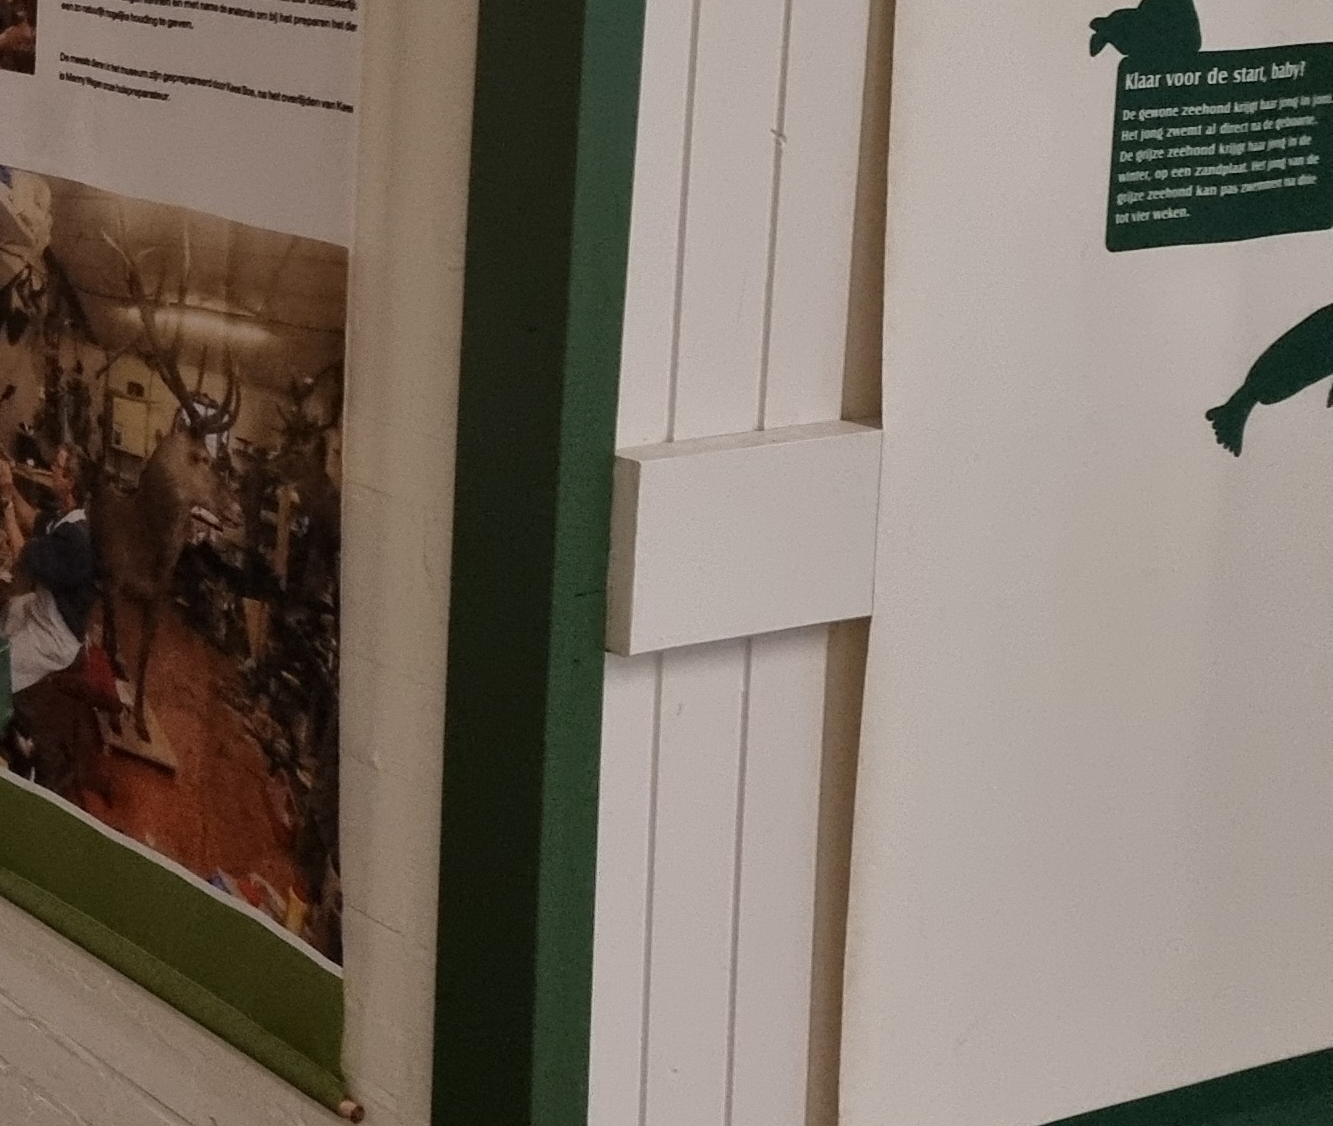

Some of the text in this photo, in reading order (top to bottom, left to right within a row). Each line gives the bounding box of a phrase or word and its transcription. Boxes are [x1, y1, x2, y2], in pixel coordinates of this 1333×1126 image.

[1125, 72, 1161, 90] Klaar
[1166, 72, 1201, 86] voor
[1207, 68, 1228, 84] de
[1123, 110, 1136, 120] De
[1181, 102, 1231, 115] zeehond
[1121, 130, 1138, 141] Het
[1205, 123, 1216, 134] al
[1119, 151, 1133, 162] De
[1167, 144, 1216, 157] zeehond
[1155, 170, 1168, 180] op
[1171, 168, 1191, 177] een
[1196, 185, 1217, 196] kan
